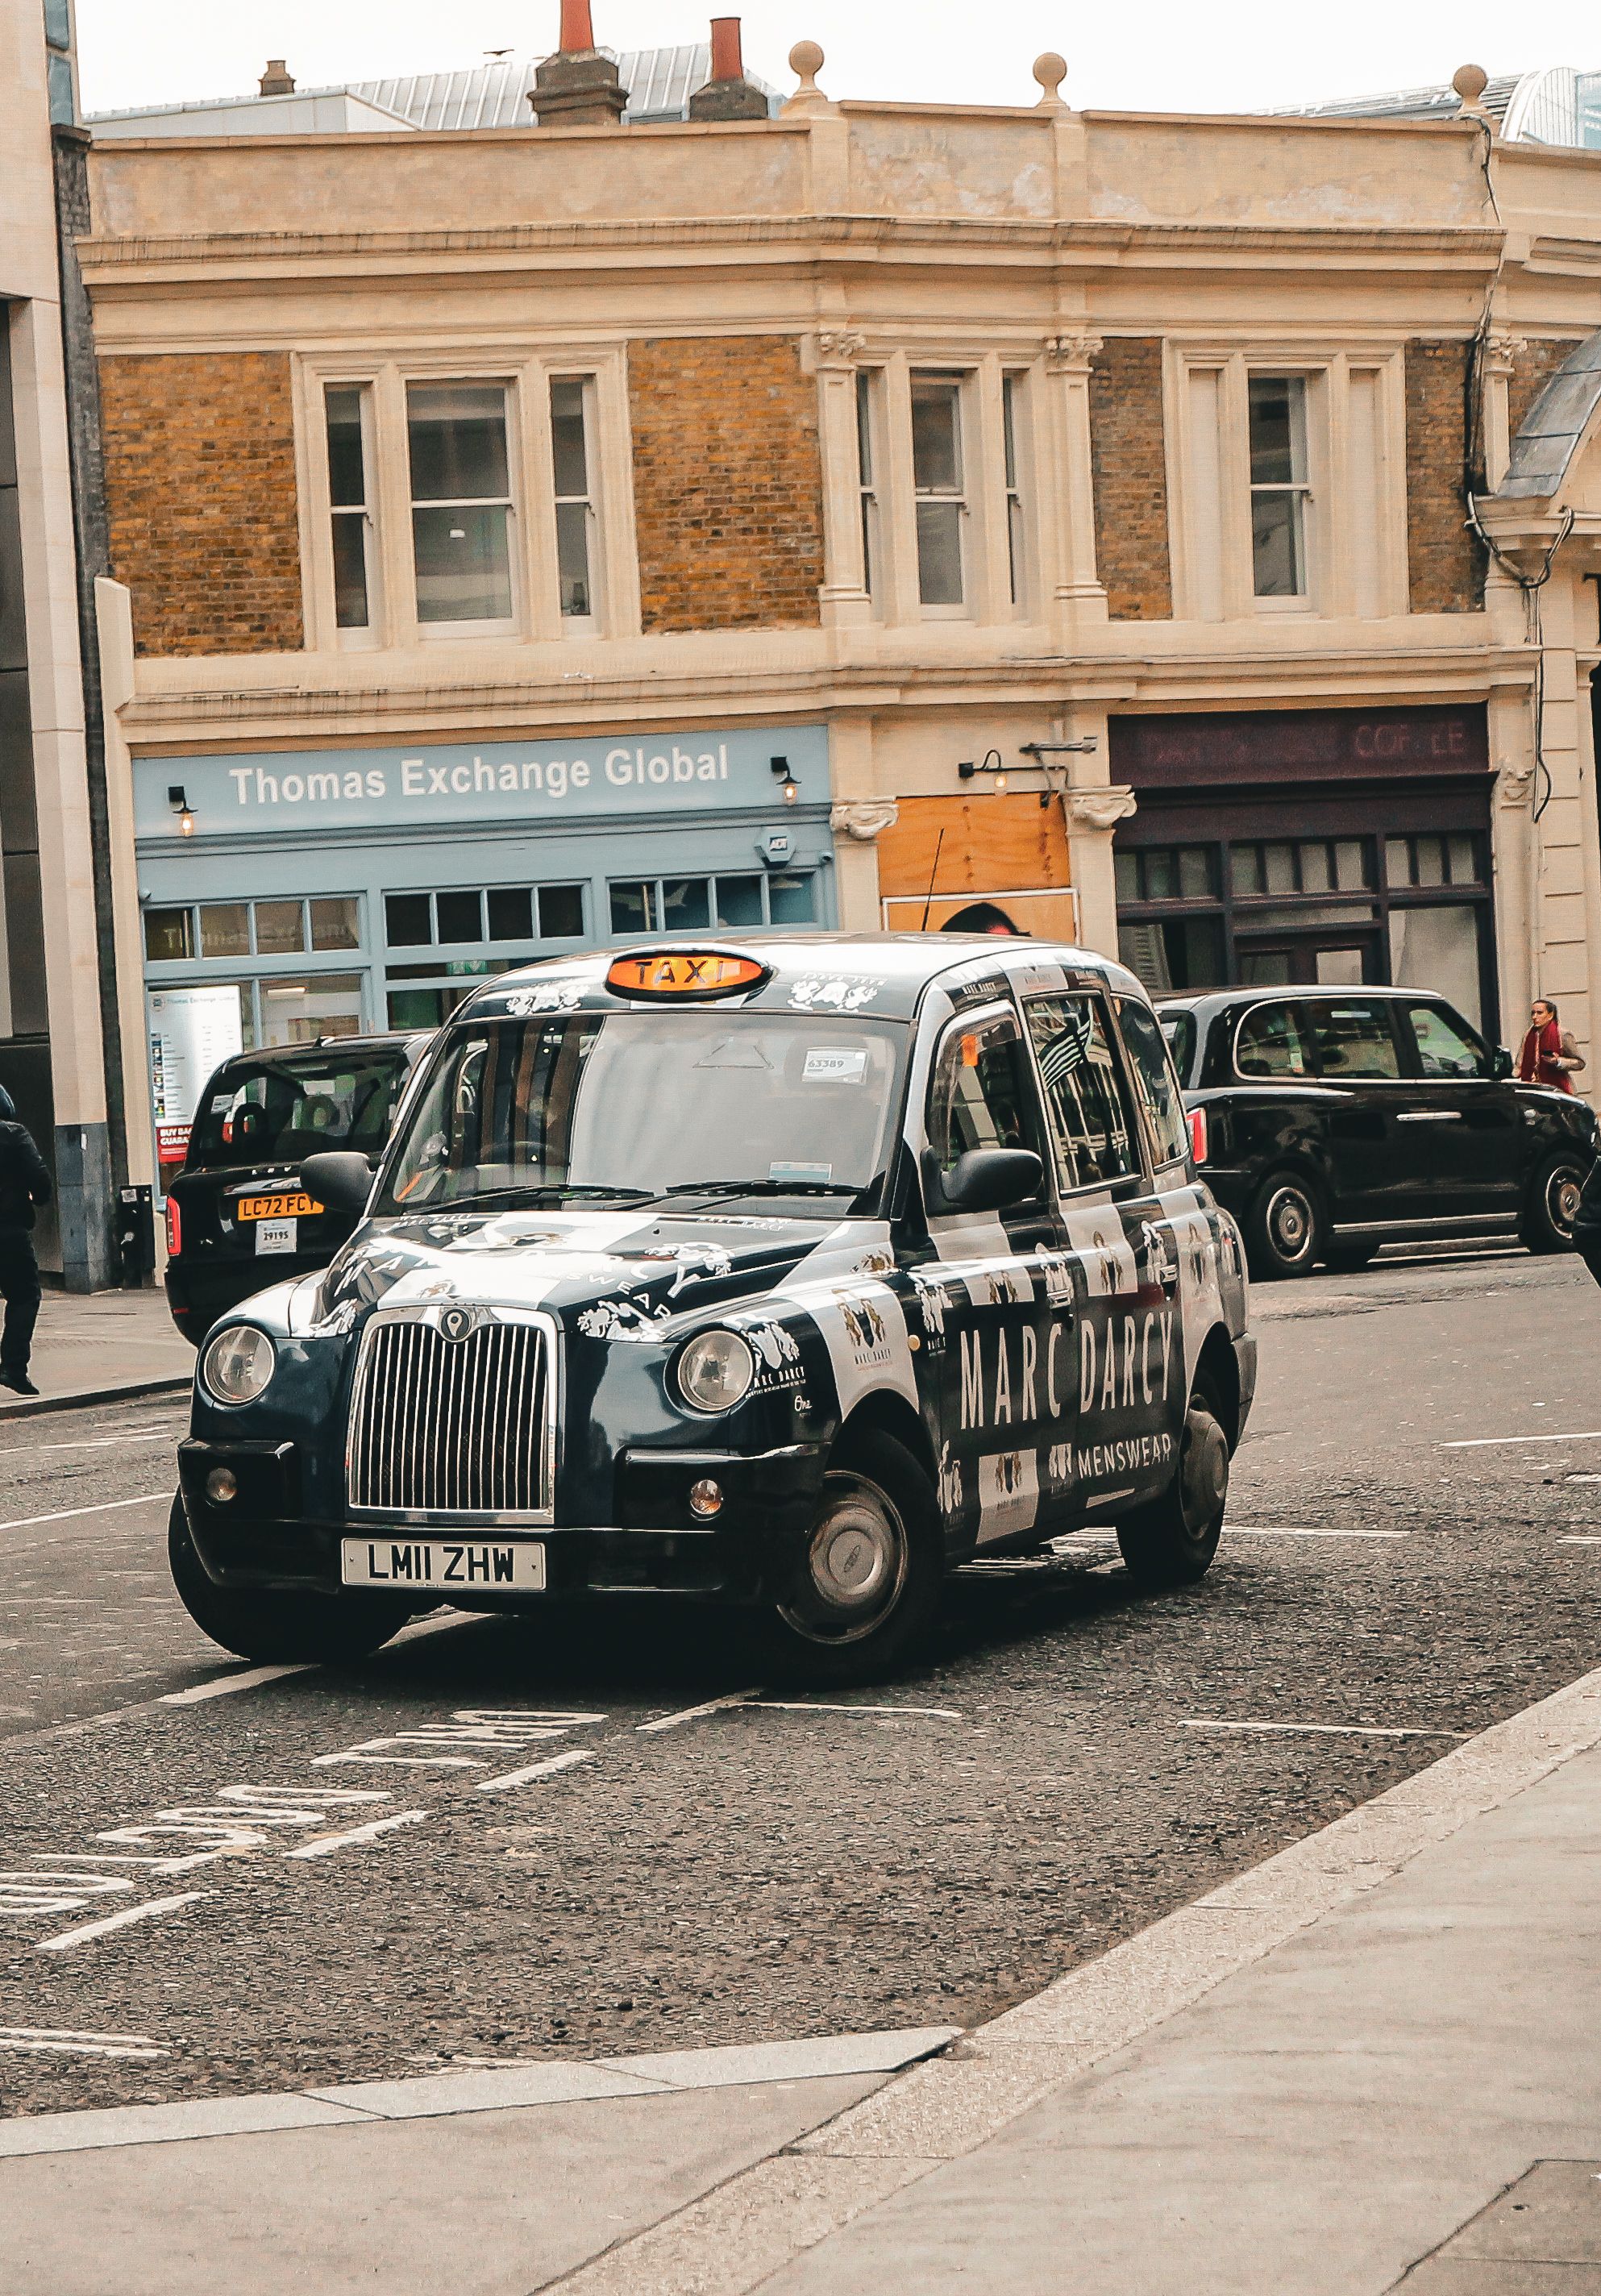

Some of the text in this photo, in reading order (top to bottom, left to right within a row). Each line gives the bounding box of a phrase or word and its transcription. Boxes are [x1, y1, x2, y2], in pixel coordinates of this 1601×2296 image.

[228, 744, 729, 805] Thomas Exchange Global
[634, 959, 725, 984] TAXI
[807, 1059, 846, 1069] 63389
[243, 1198, 282, 1217] LC72
[754, 1373, 774, 1388] ARC
[960, 1311, 1174, 1430] MARC DARCY
[1077, 1433, 1171, 1479] MENSWEAR
[368, 1544, 514, 1583] LM11 ZHW
